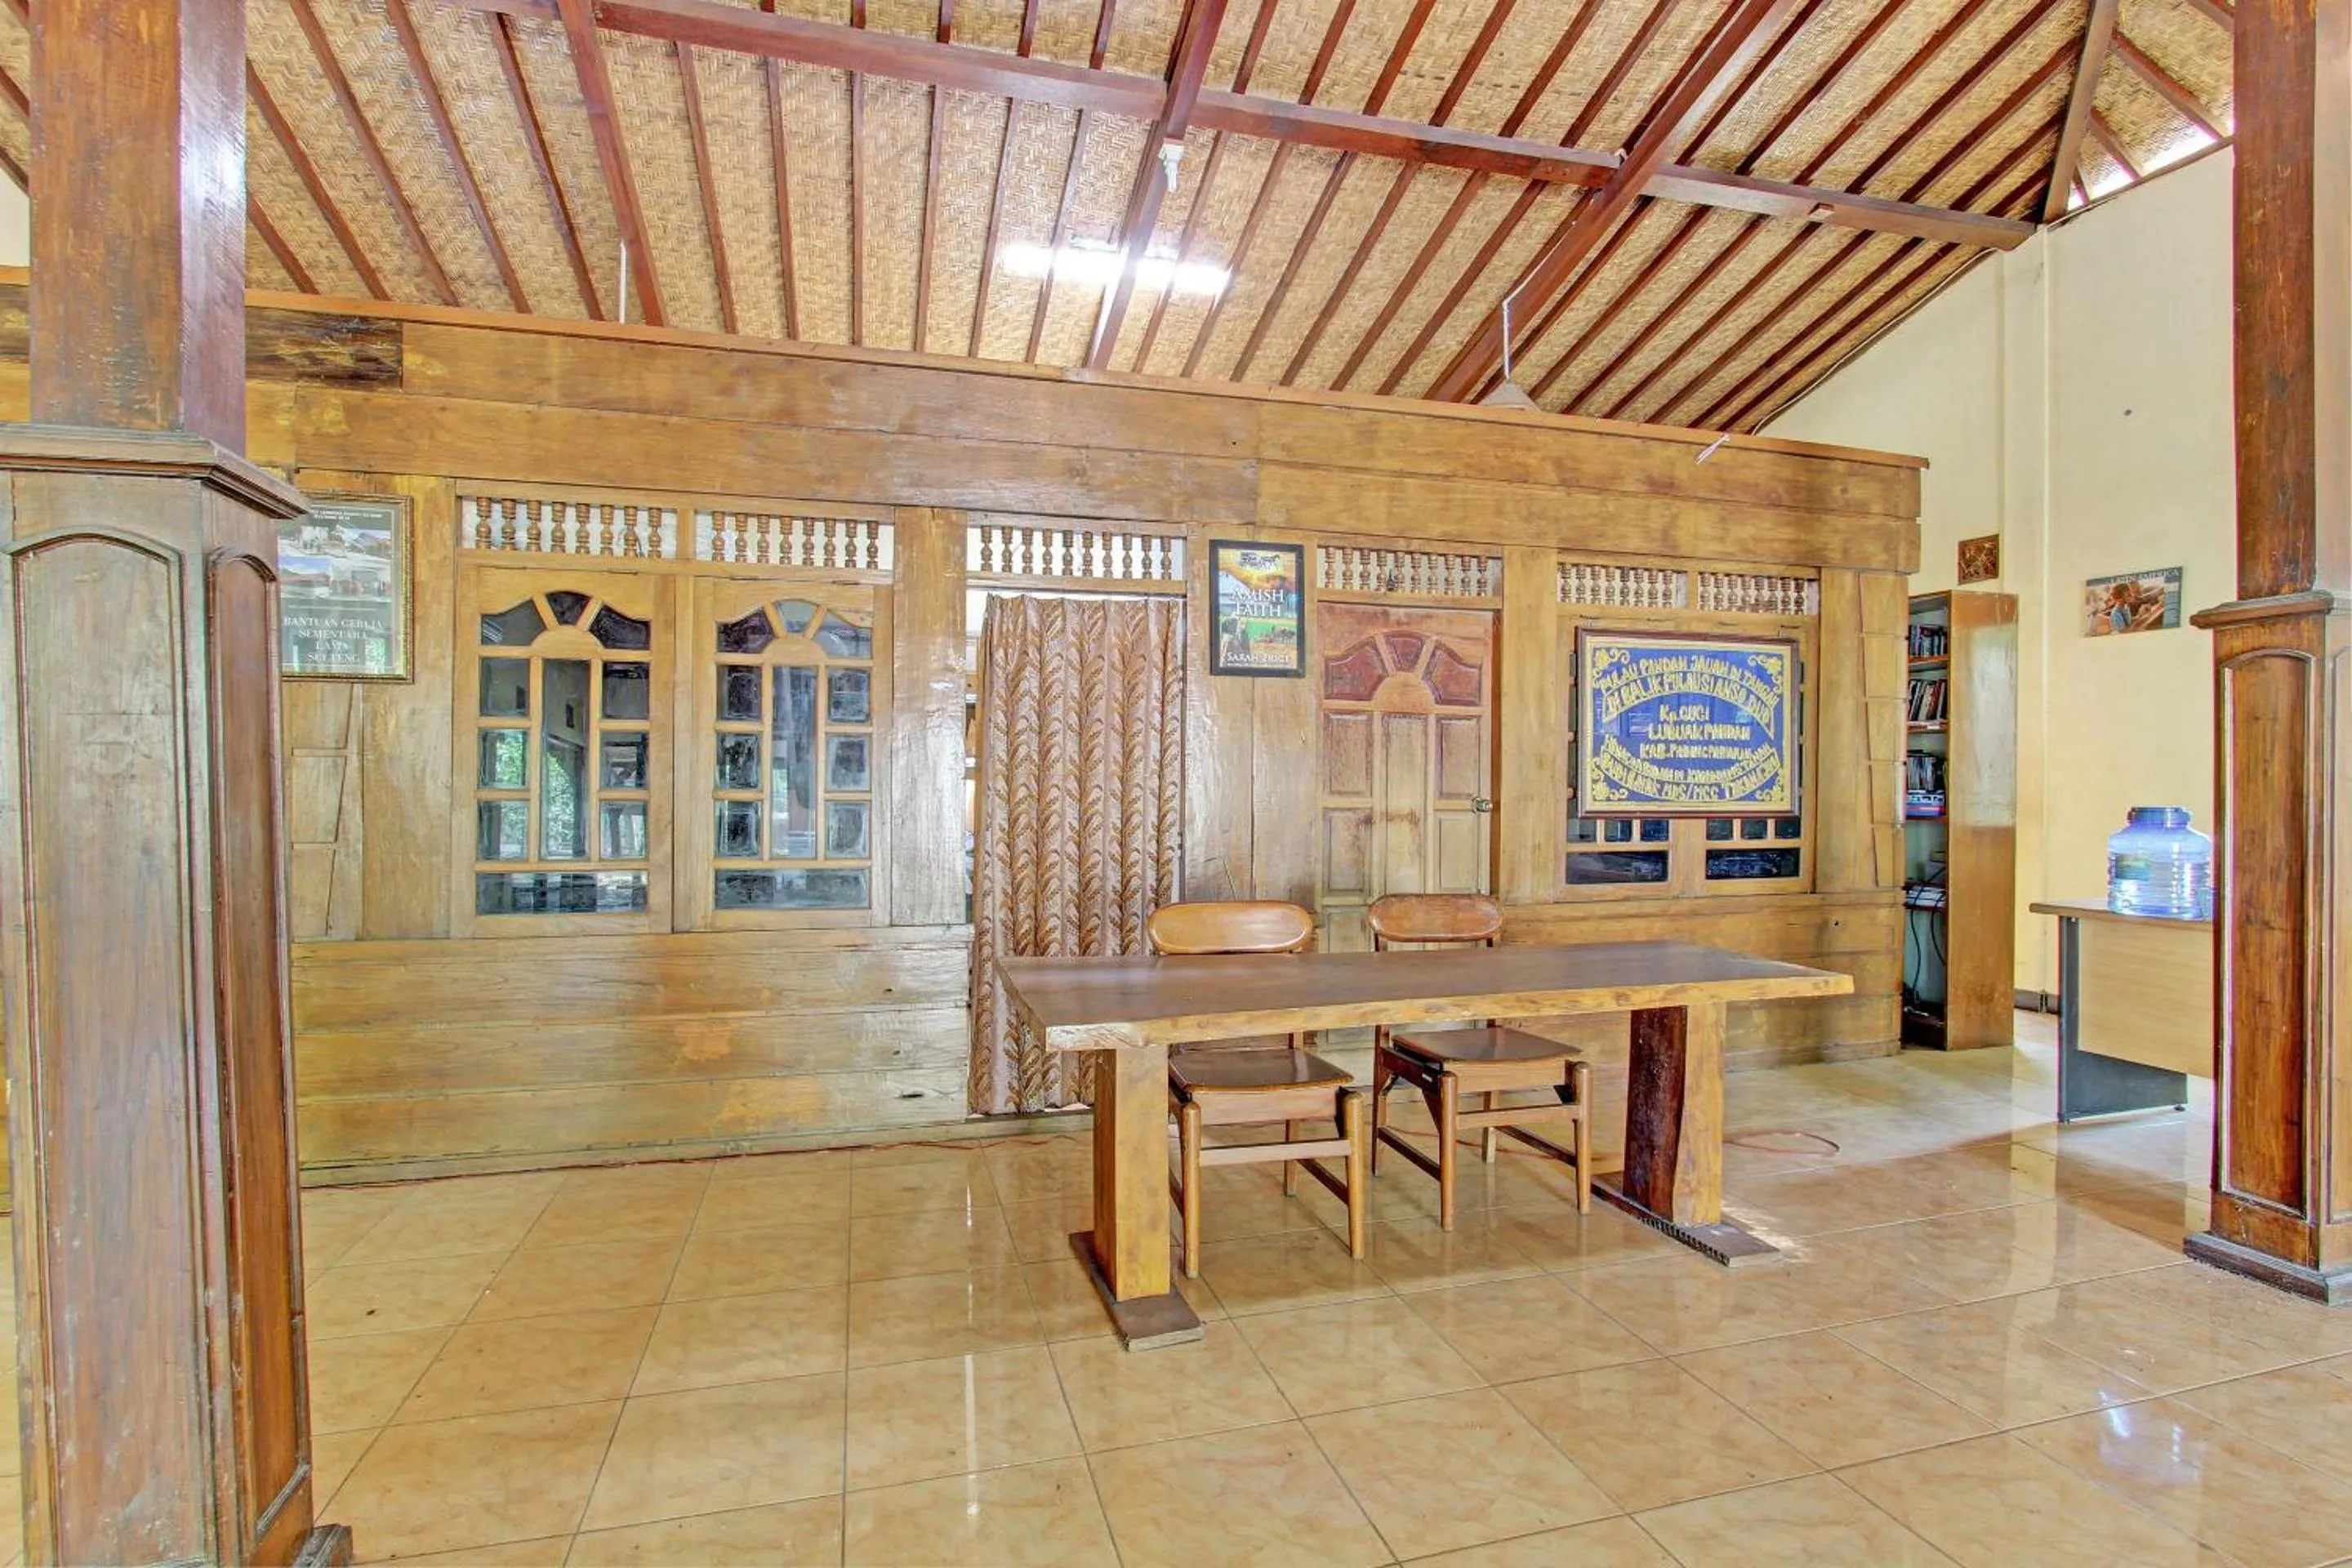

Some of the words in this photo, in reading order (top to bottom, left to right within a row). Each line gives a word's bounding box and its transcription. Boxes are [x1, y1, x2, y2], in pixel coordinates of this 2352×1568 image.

[2139, 569, 2179, 581] AMERICA
[1232, 588, 1284, 603] AMISH
[1236, 603, 1281, 617] FAITH
